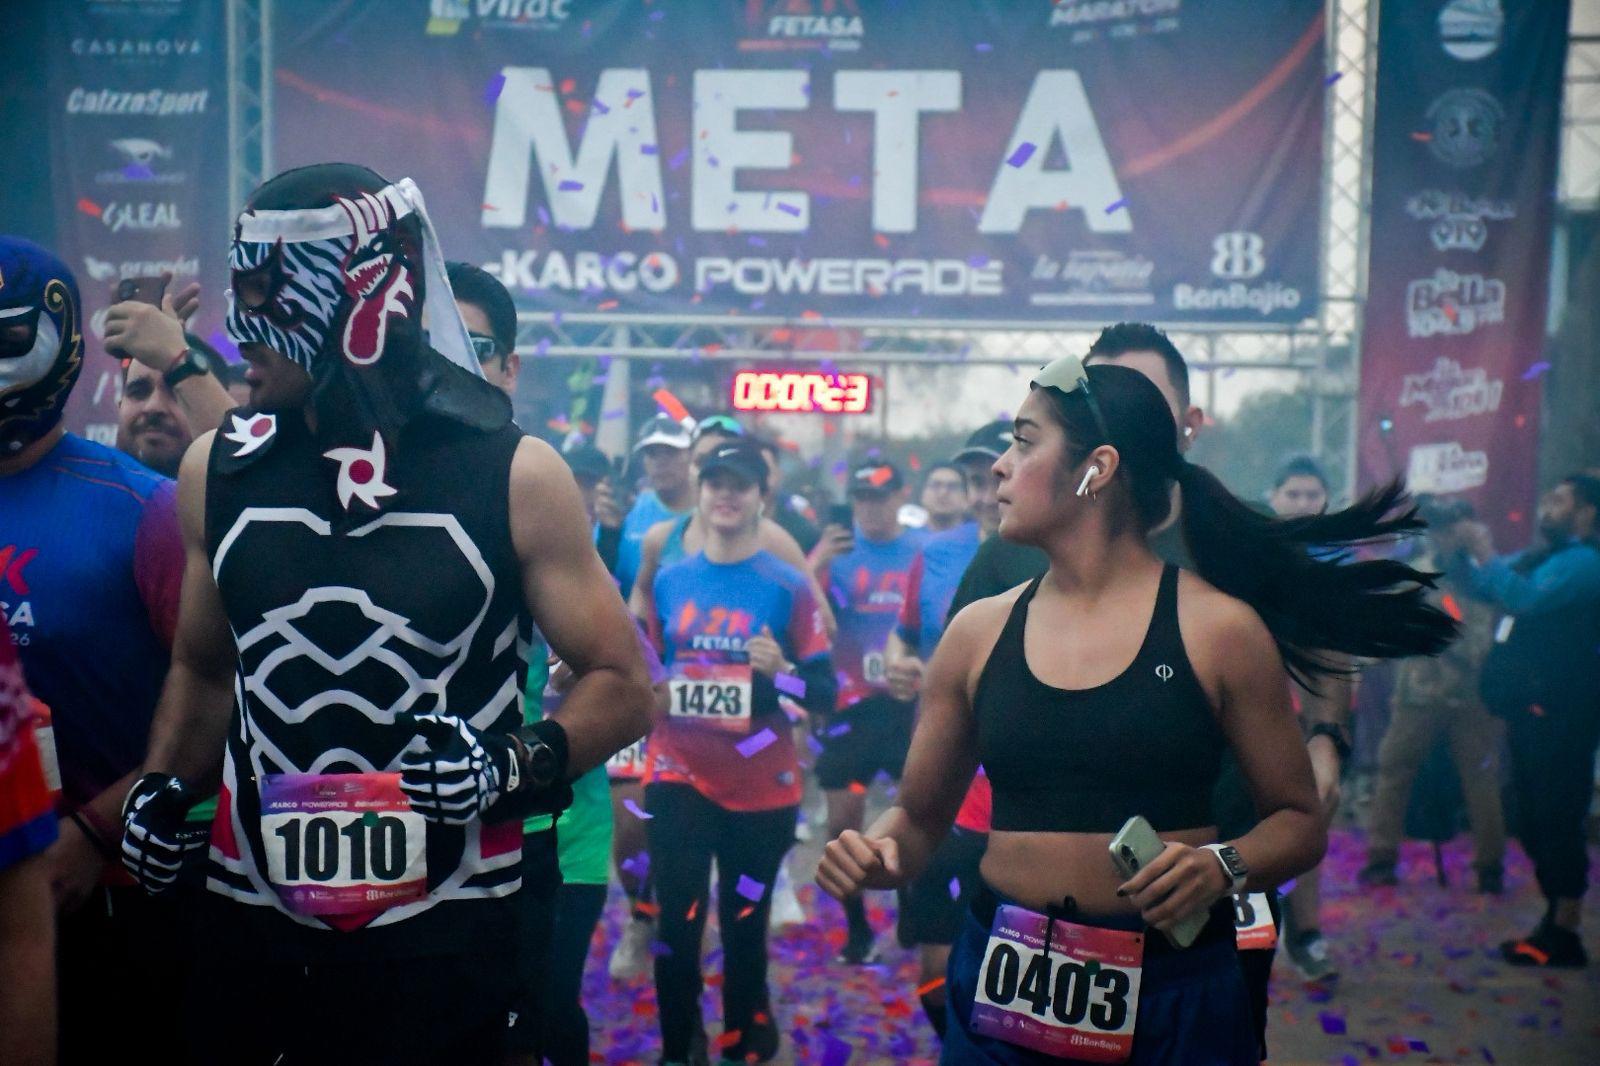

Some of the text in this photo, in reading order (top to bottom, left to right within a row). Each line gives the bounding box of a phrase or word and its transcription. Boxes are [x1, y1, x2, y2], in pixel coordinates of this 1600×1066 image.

[769, 15, 865, 37] FETASA
[71, 38, 201, 55] CASANOVA
[481, 66, 1132, 233] META
[695, 256, 1003, 294] POWERADE
[676, 685, 742, 716] 1423
[275, 816, 407, 882] 1010
[984, 942, 1131, 1031] 0403
